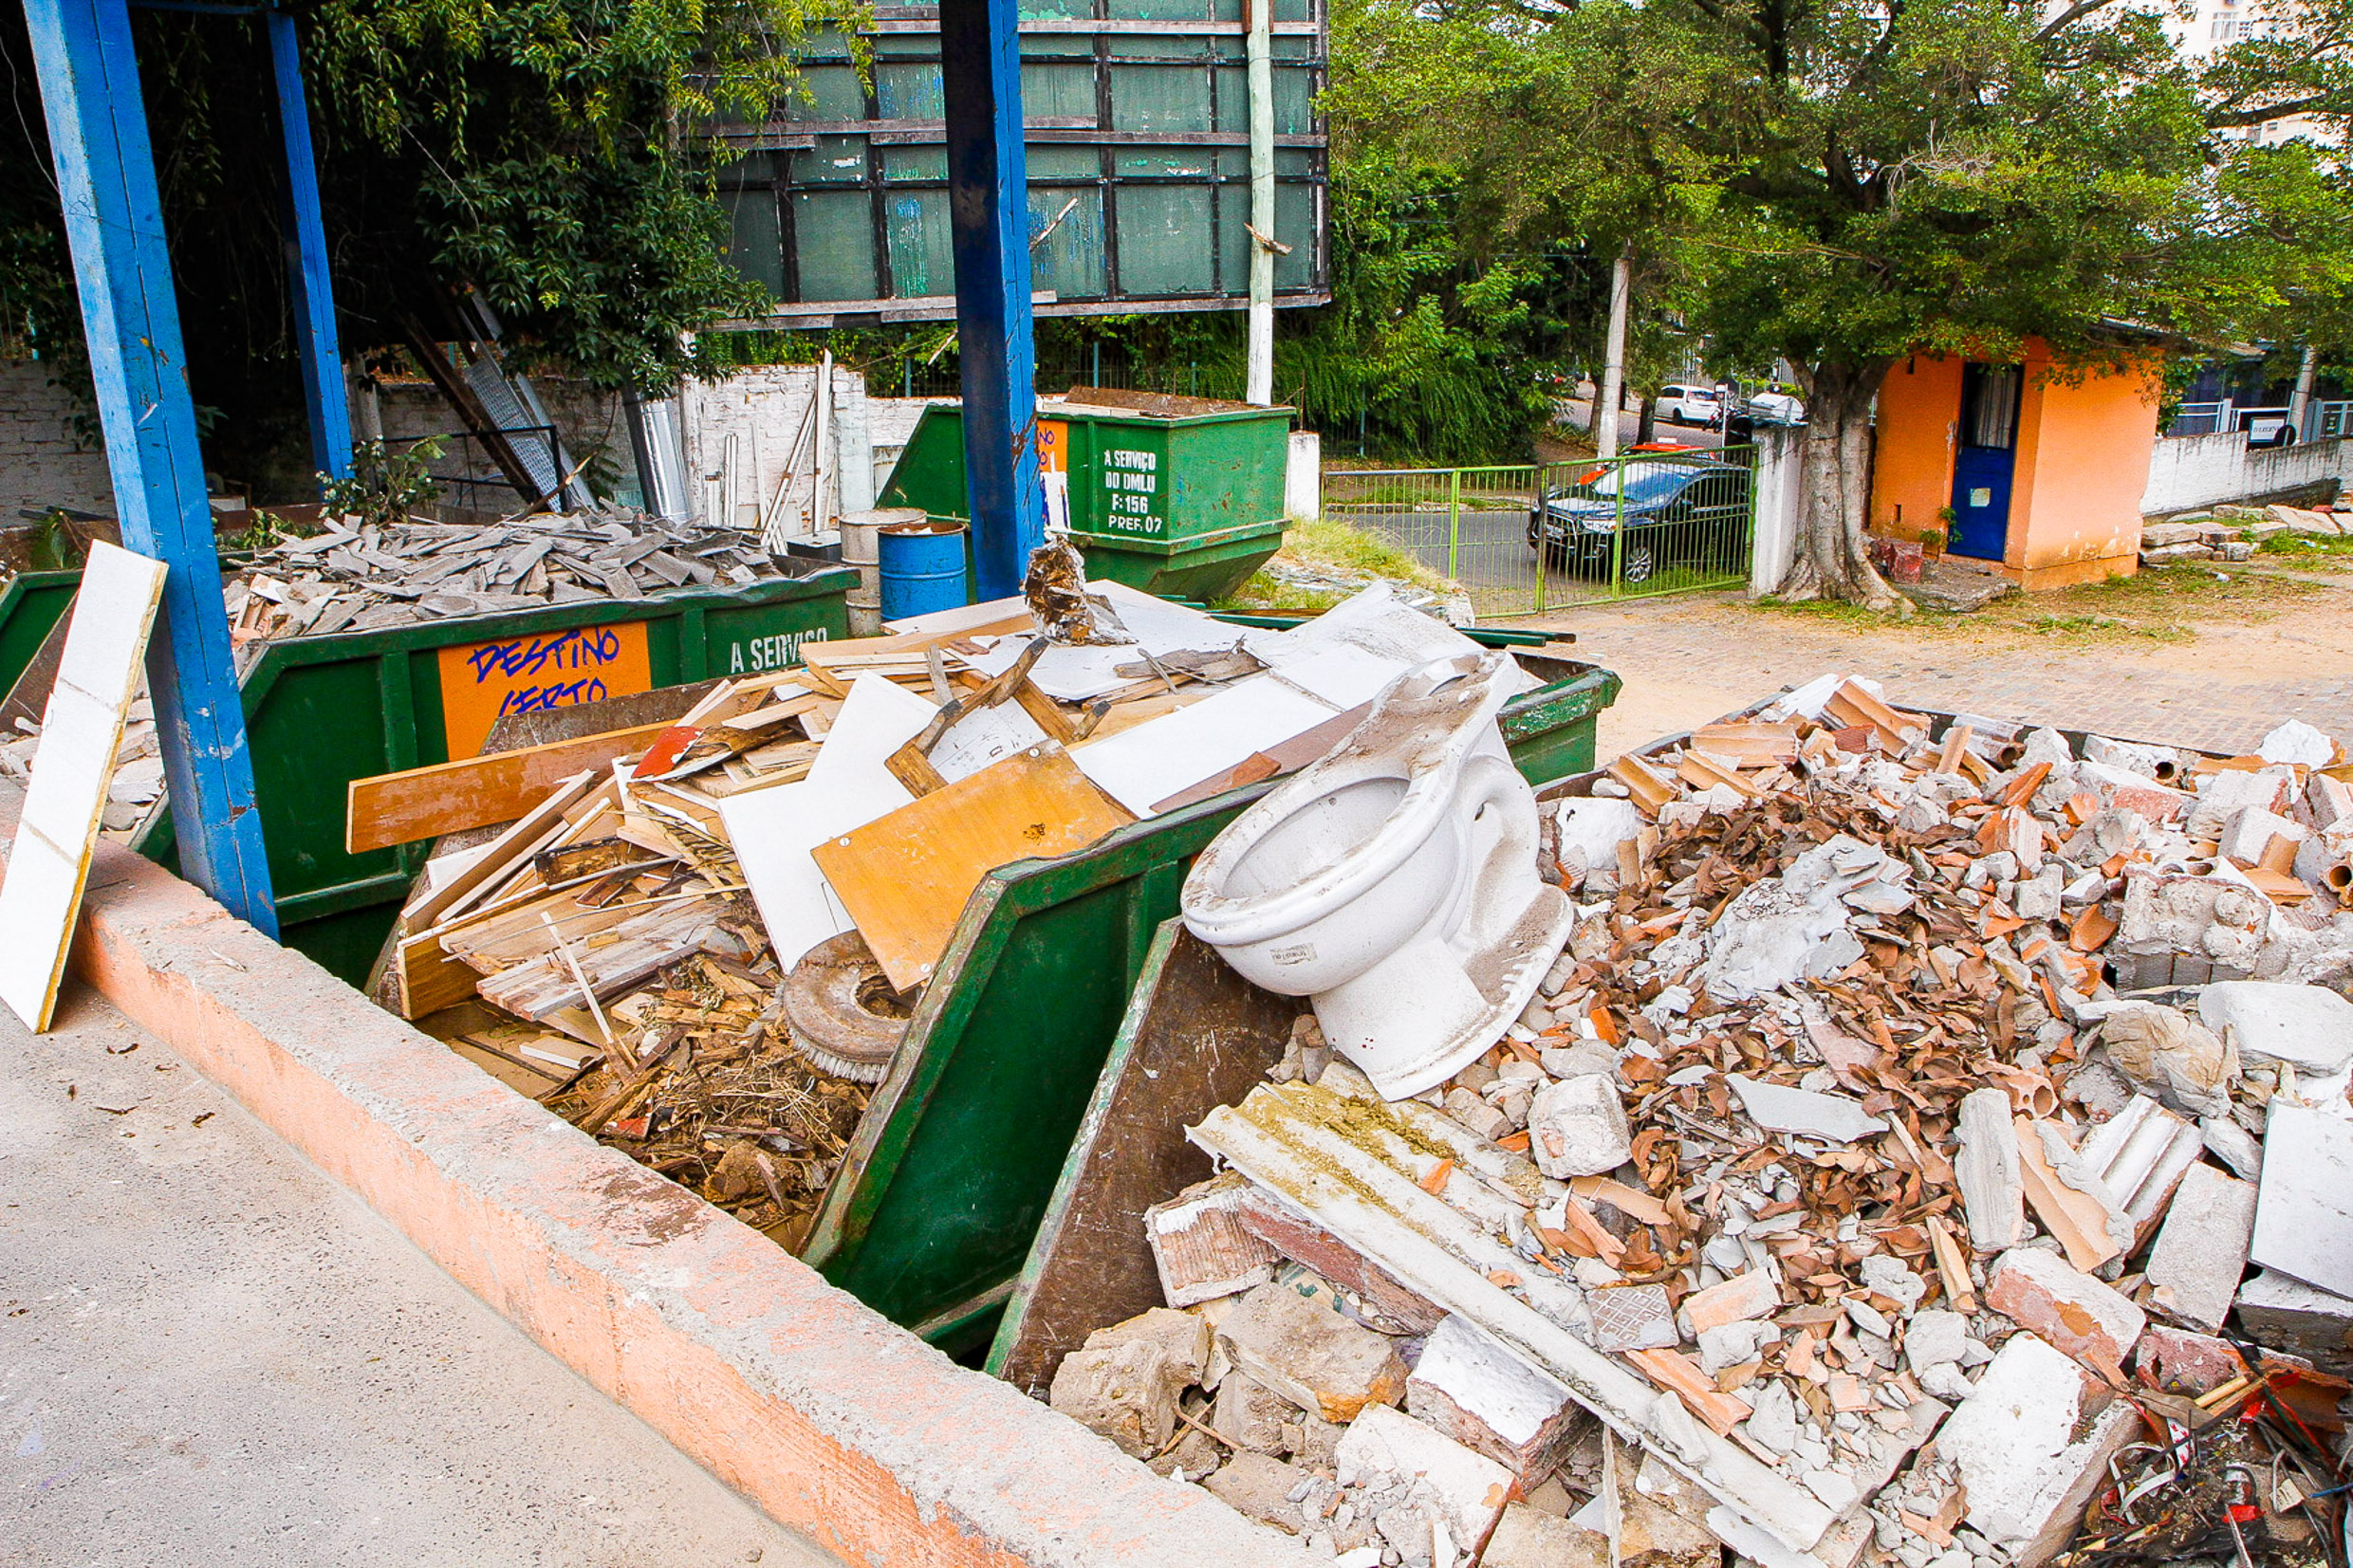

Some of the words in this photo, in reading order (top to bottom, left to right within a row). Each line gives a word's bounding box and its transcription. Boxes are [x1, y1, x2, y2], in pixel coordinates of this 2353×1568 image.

[1103, 450, 1112, 467] A
[1114, 450, 1157, 472] SERVIÇO
[1105, 471, 1120, 489] DO
[1122, 472, 1156, 493] DMLU
[1145, 516, 1162, 533] 07
[467, 626, 620, 684] DESTINO
[731, 641, 745, 673] A
